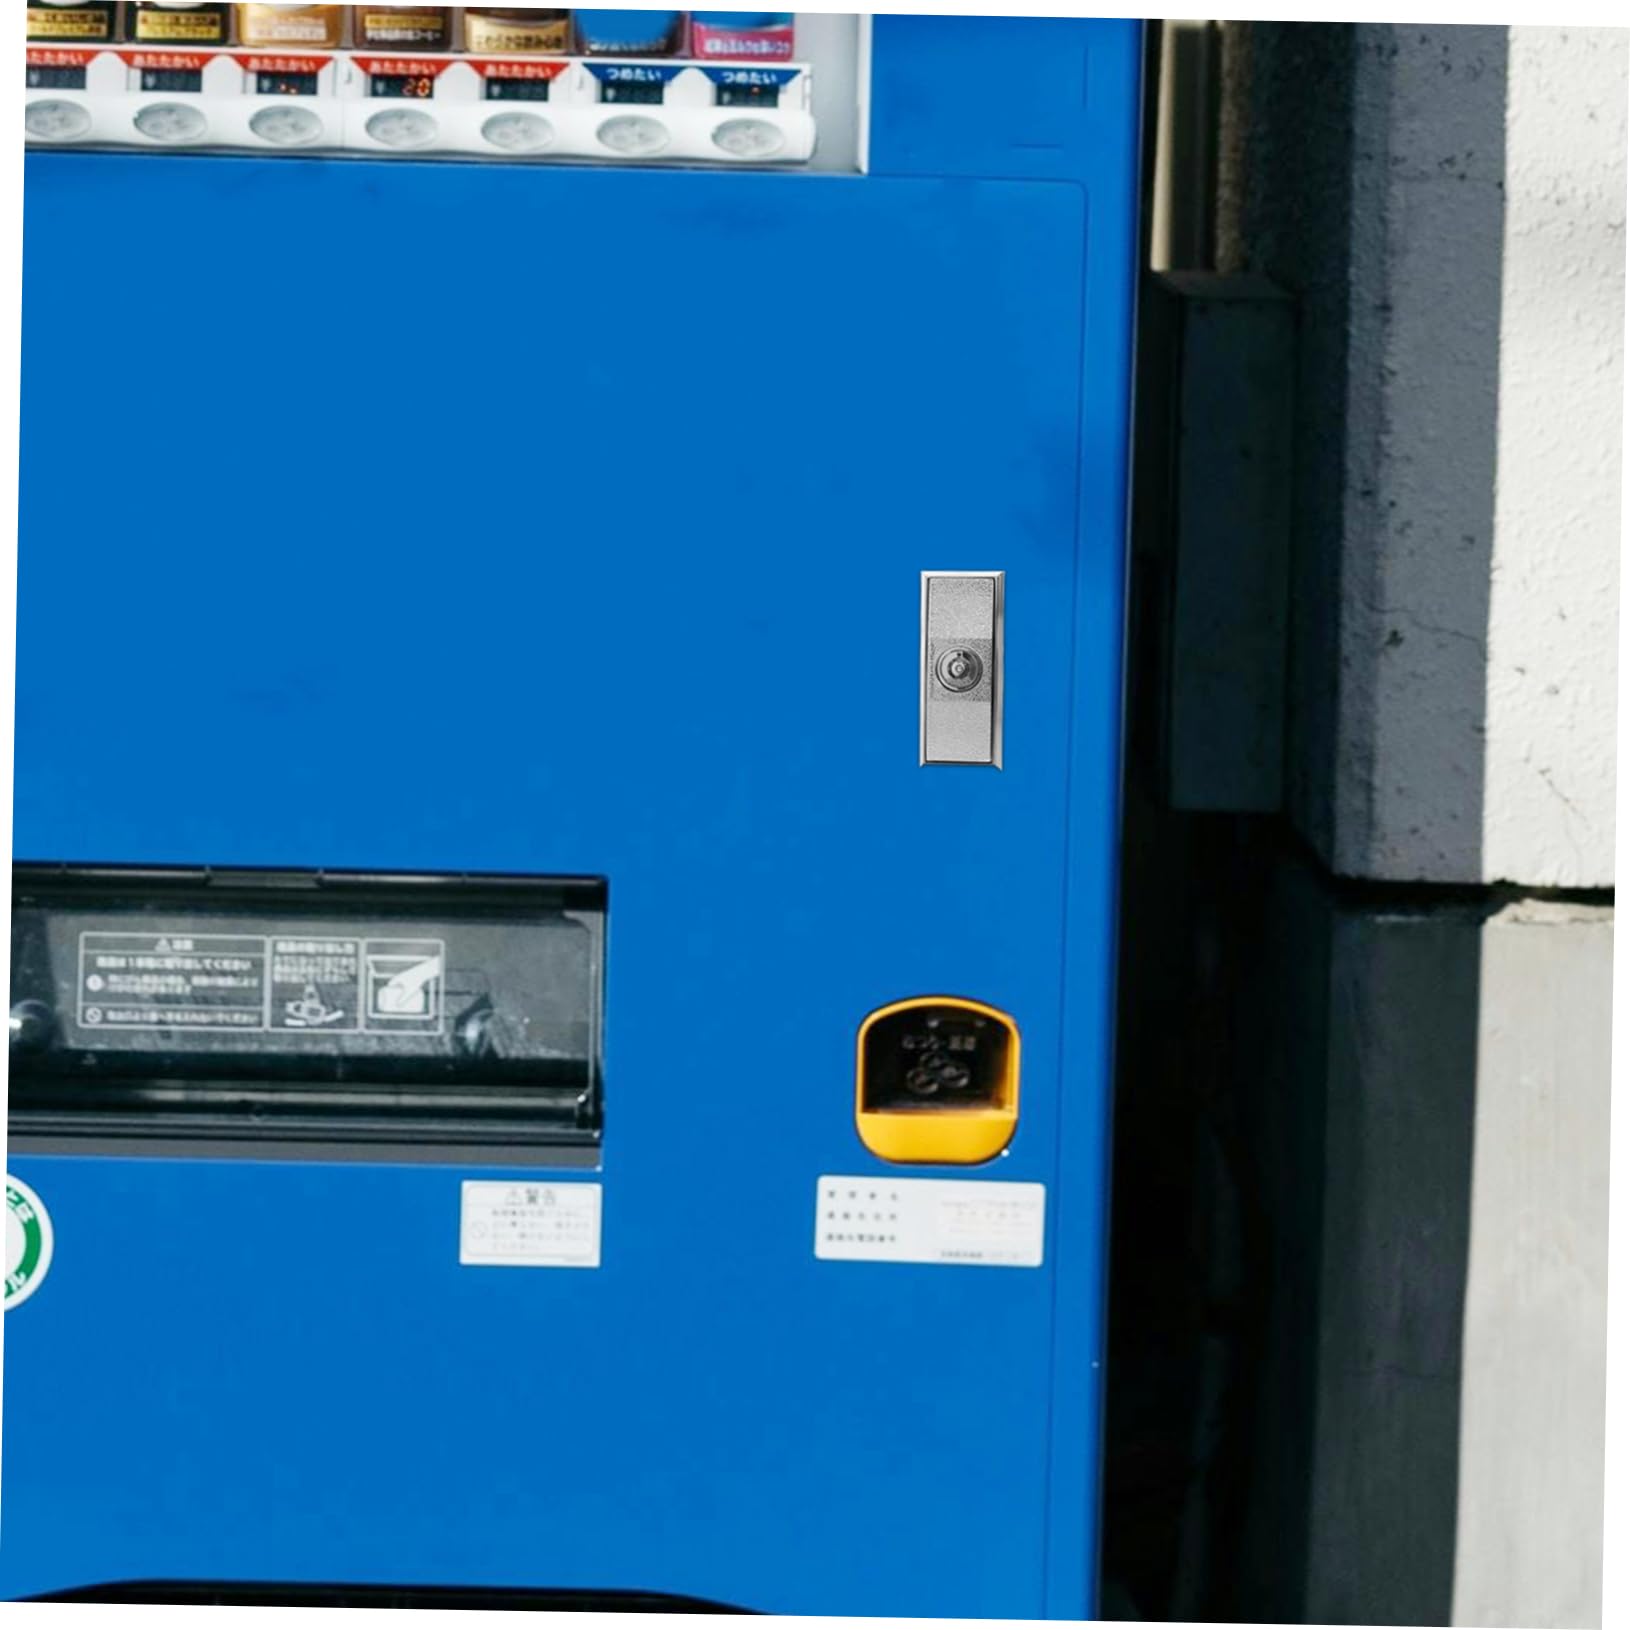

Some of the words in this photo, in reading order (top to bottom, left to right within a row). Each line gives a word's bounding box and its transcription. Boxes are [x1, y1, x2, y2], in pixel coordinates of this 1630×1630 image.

[26, 51, 85, 66] たたかい
[132, 53, 200, 68] あたたかい
[247, 57, 315, 72] あたたかい
[368, 60, 437, 75] あたたかい
[484, 63, 552, 78] あたたかい
[605, 67, 663, 81] つめたい
[721, 71, 777, 84] つめたい
[402, 78, 430, 97] 20
